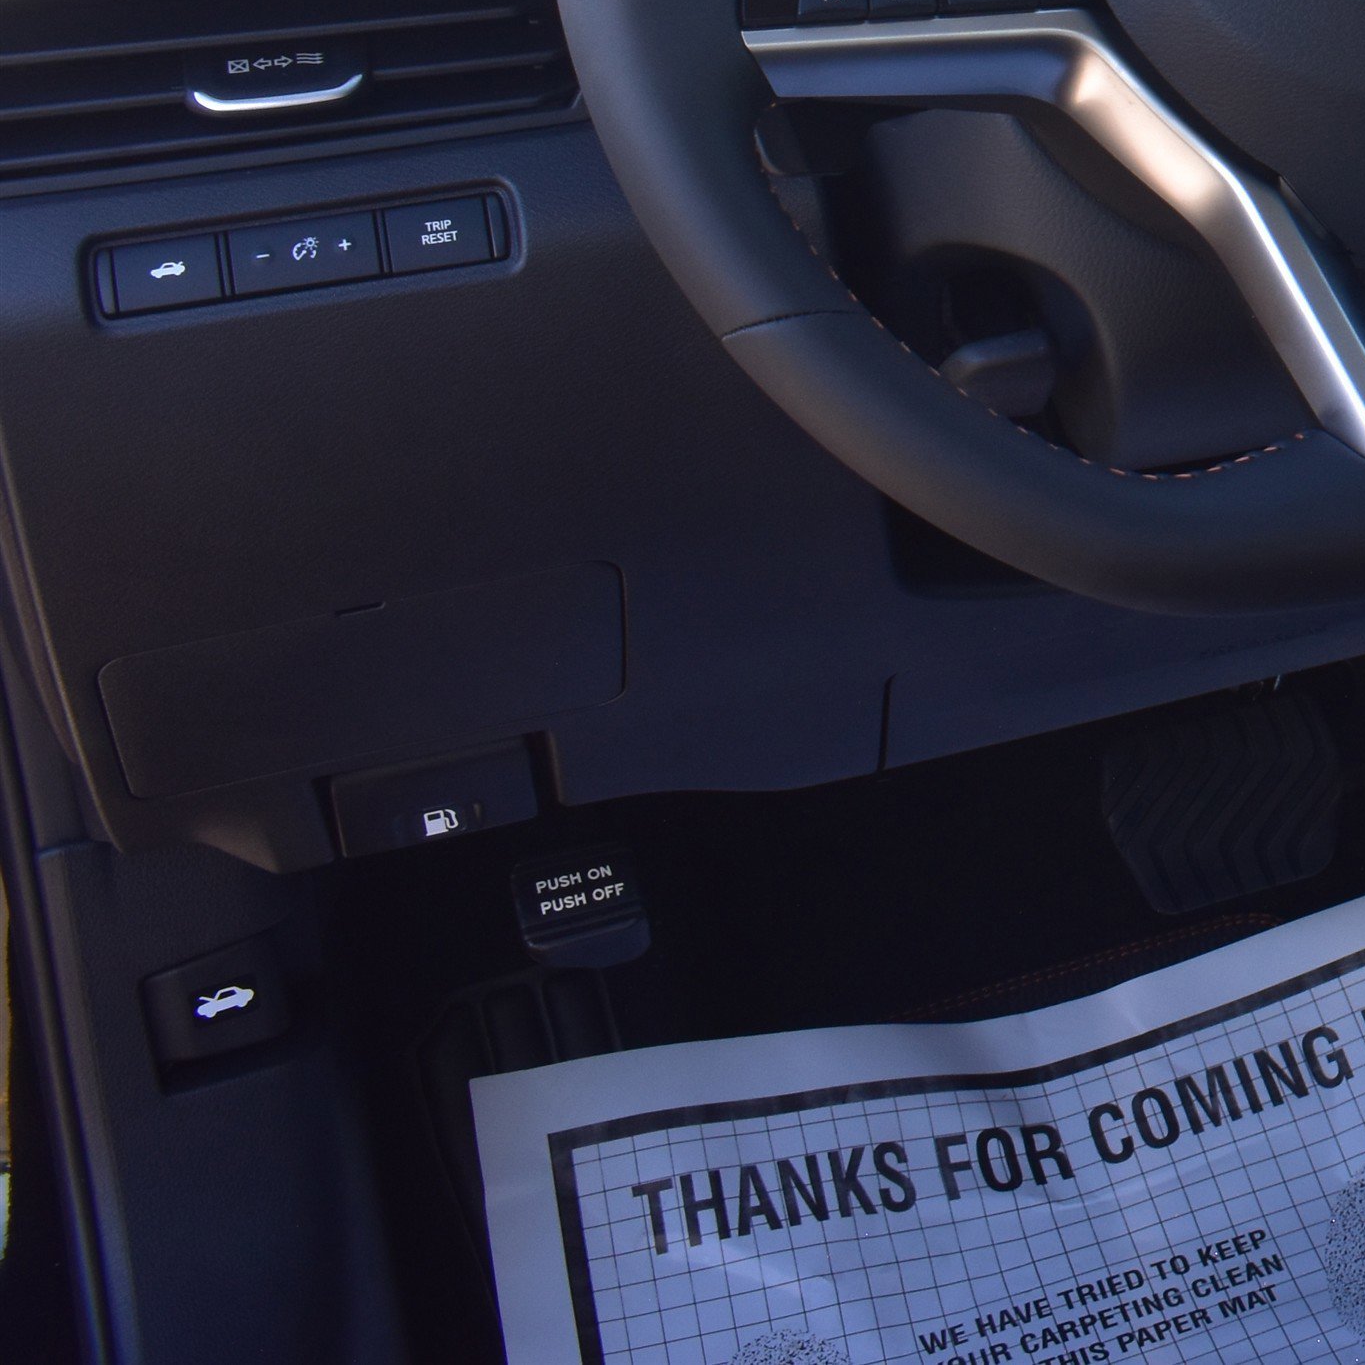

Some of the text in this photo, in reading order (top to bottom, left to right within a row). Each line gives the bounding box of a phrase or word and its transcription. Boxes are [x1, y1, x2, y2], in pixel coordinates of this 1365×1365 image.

[421, 230, 458, 245] RESET
[425, 219, 452, 232] TRIP
[536, 865, 613, 894] PUSH ON
[540, 882, 625, 916] PUSH OFF
[631, 1140, 917, 1255] THANKS
[935, 1123, 1075, 1202] FOR
[1087, 1025, 1355, 1165] COMING
[919, 1228, 1268, 1356] WE HAVE TRIED TO KEEP
[1019, 1286, 1186, 1355] CARPETING
[1190, 1252, 1285, 1299] CLEAN
[1116, 1307, 1213, 1354] PAPER
[1218, 1282, 1280, 1319] MAT
